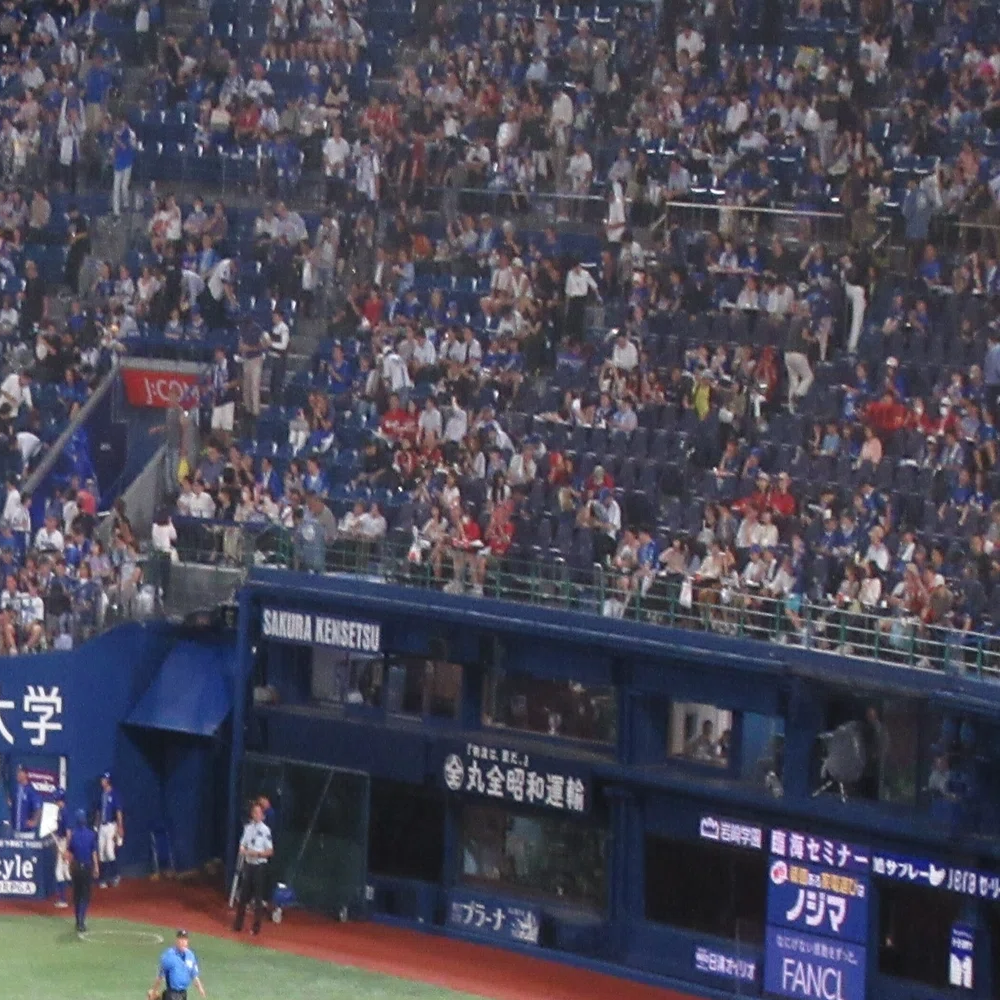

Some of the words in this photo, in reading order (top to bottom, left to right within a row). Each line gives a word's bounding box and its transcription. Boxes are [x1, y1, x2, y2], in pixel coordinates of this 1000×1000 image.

[144, 376, 199, 405] J:CO
[262, 608, 312, 643] SAKURA
[315, 616, 381, 651] KENSETSU
[466, 759, 585, 812] 丸全昭和運輸
[770, 828, 869, 867] 臨海セミナー
[785, 888, 847, 932] ノジマ
